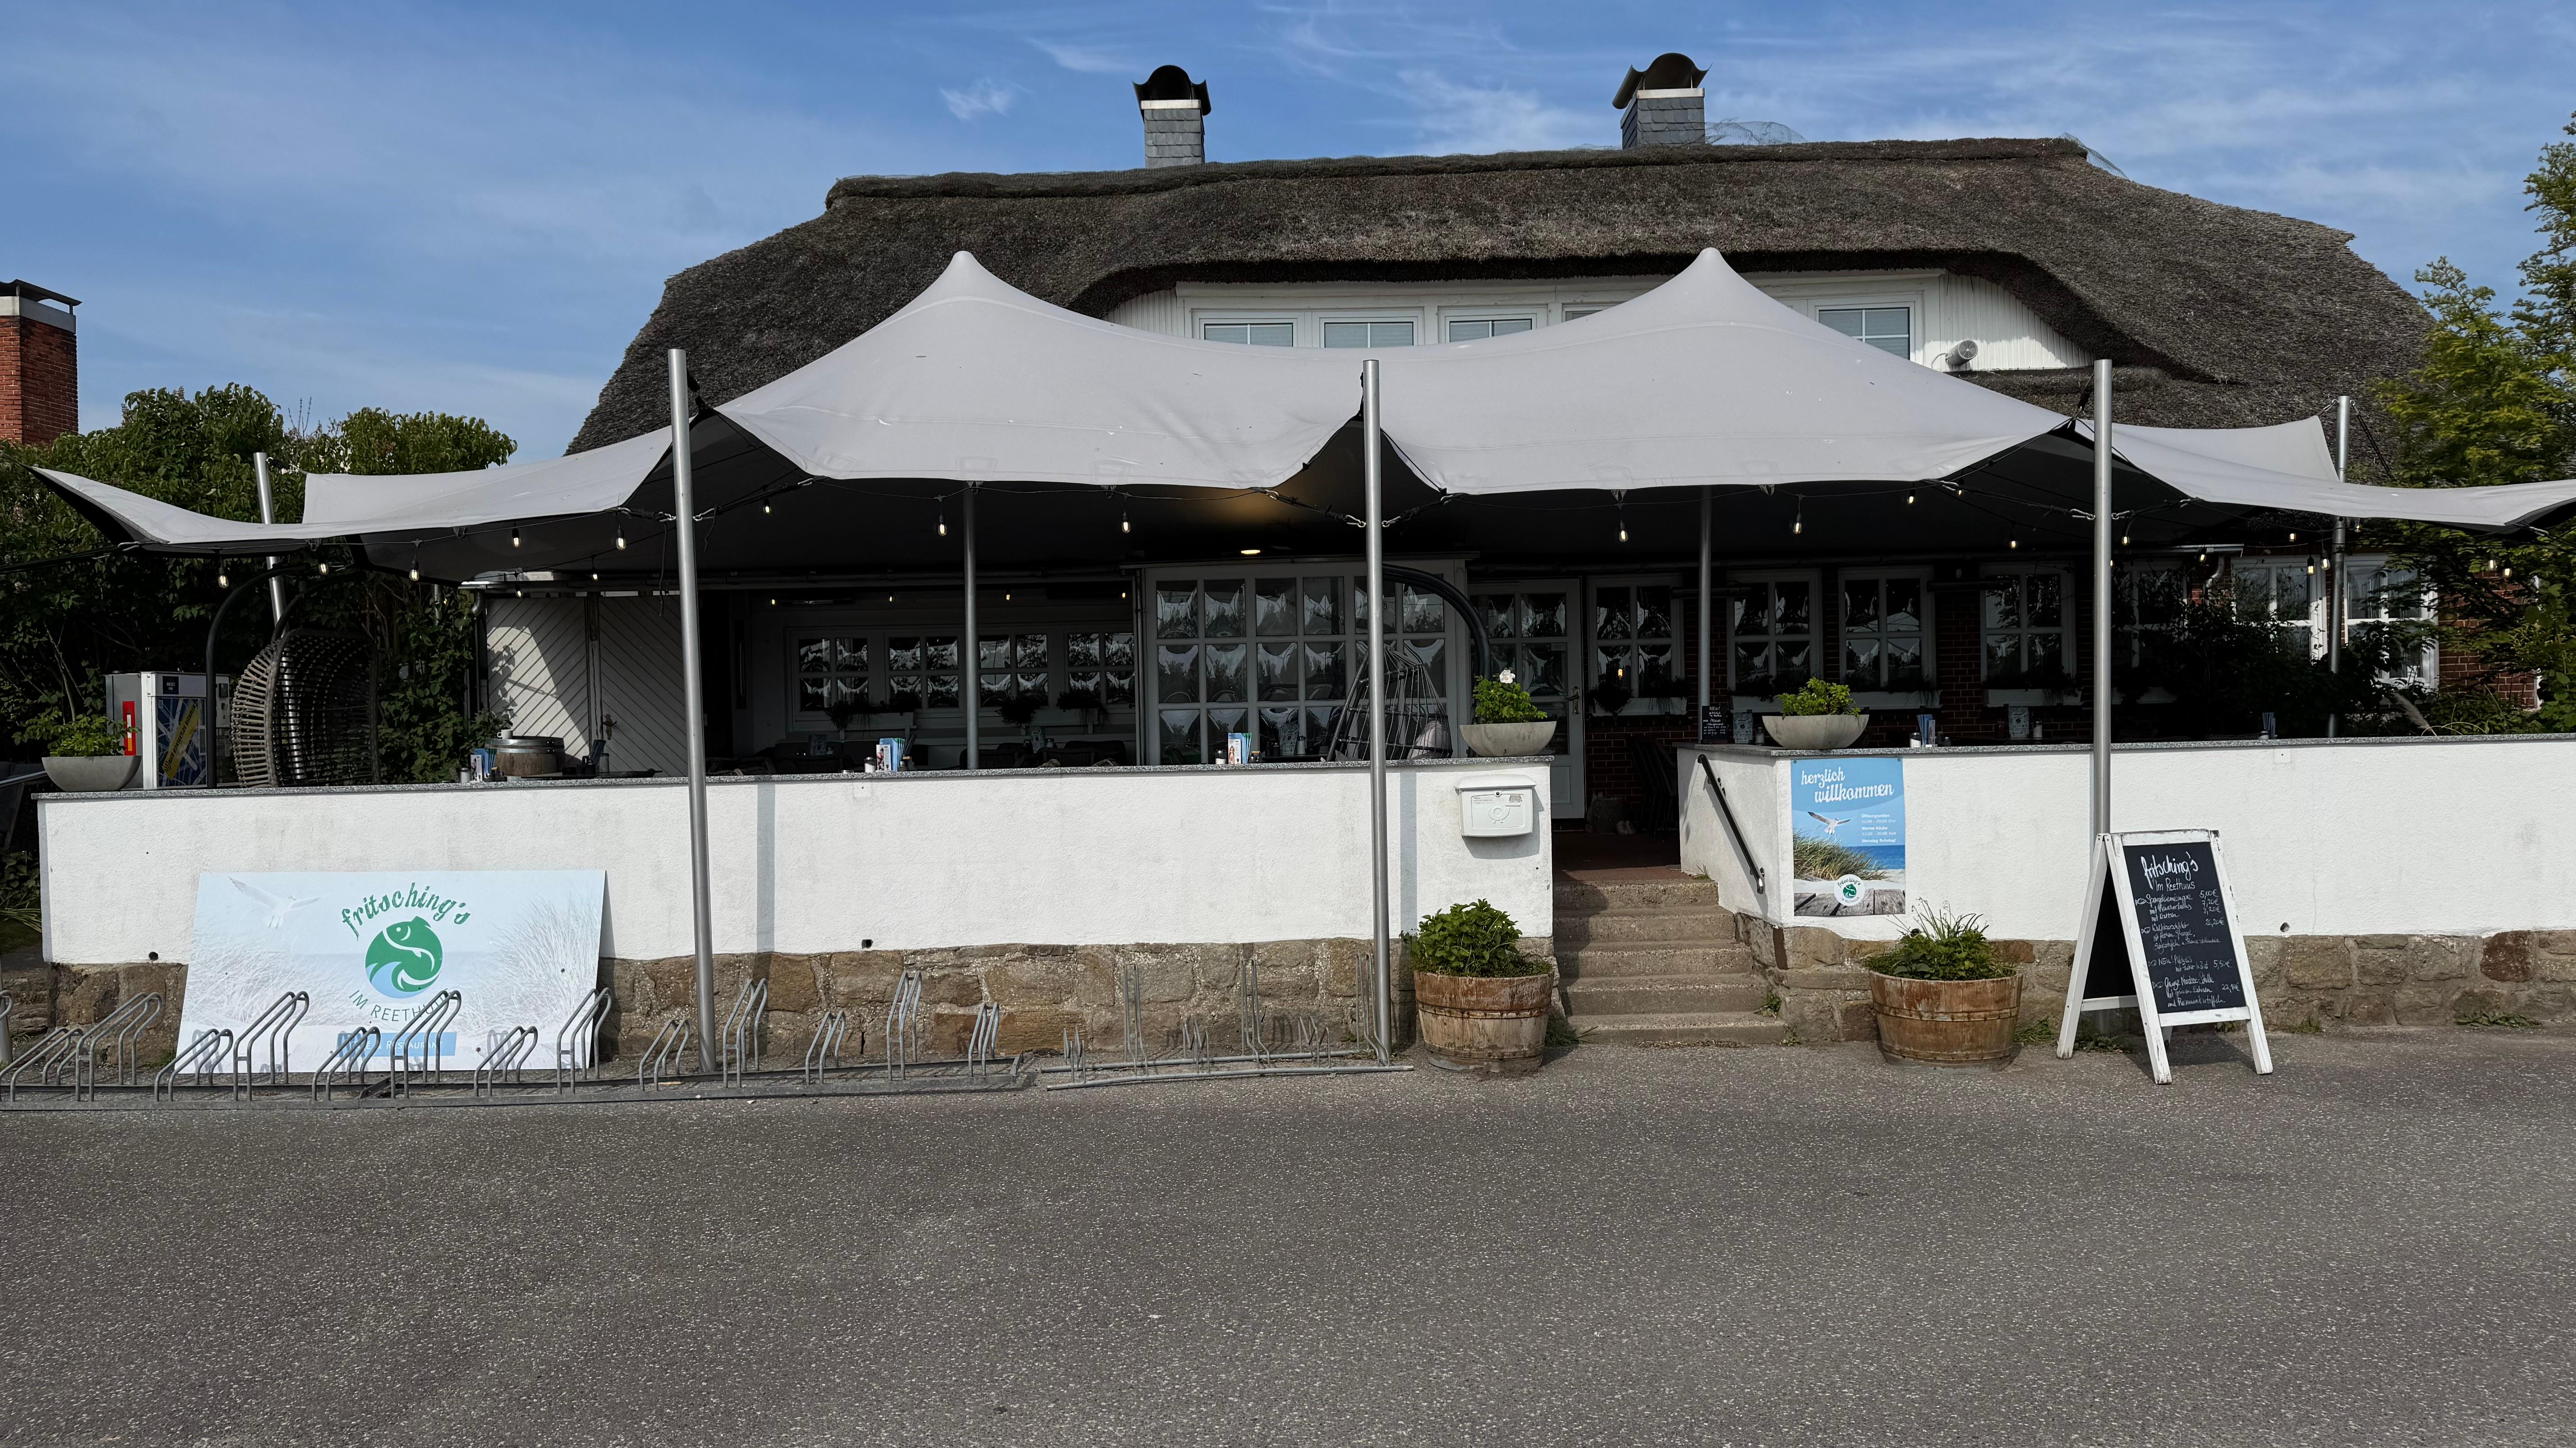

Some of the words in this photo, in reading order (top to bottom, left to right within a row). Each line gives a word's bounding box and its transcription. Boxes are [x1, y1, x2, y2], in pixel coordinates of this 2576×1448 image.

[1801, 767, 1845, 788] herzlich
[1814, 783, 1894, 803] willkommen
[2165, 878, 2195, 892] Reethuus
[341, 882, 471, 941] fritsching's
[349, 990, 368, 1009] IM
